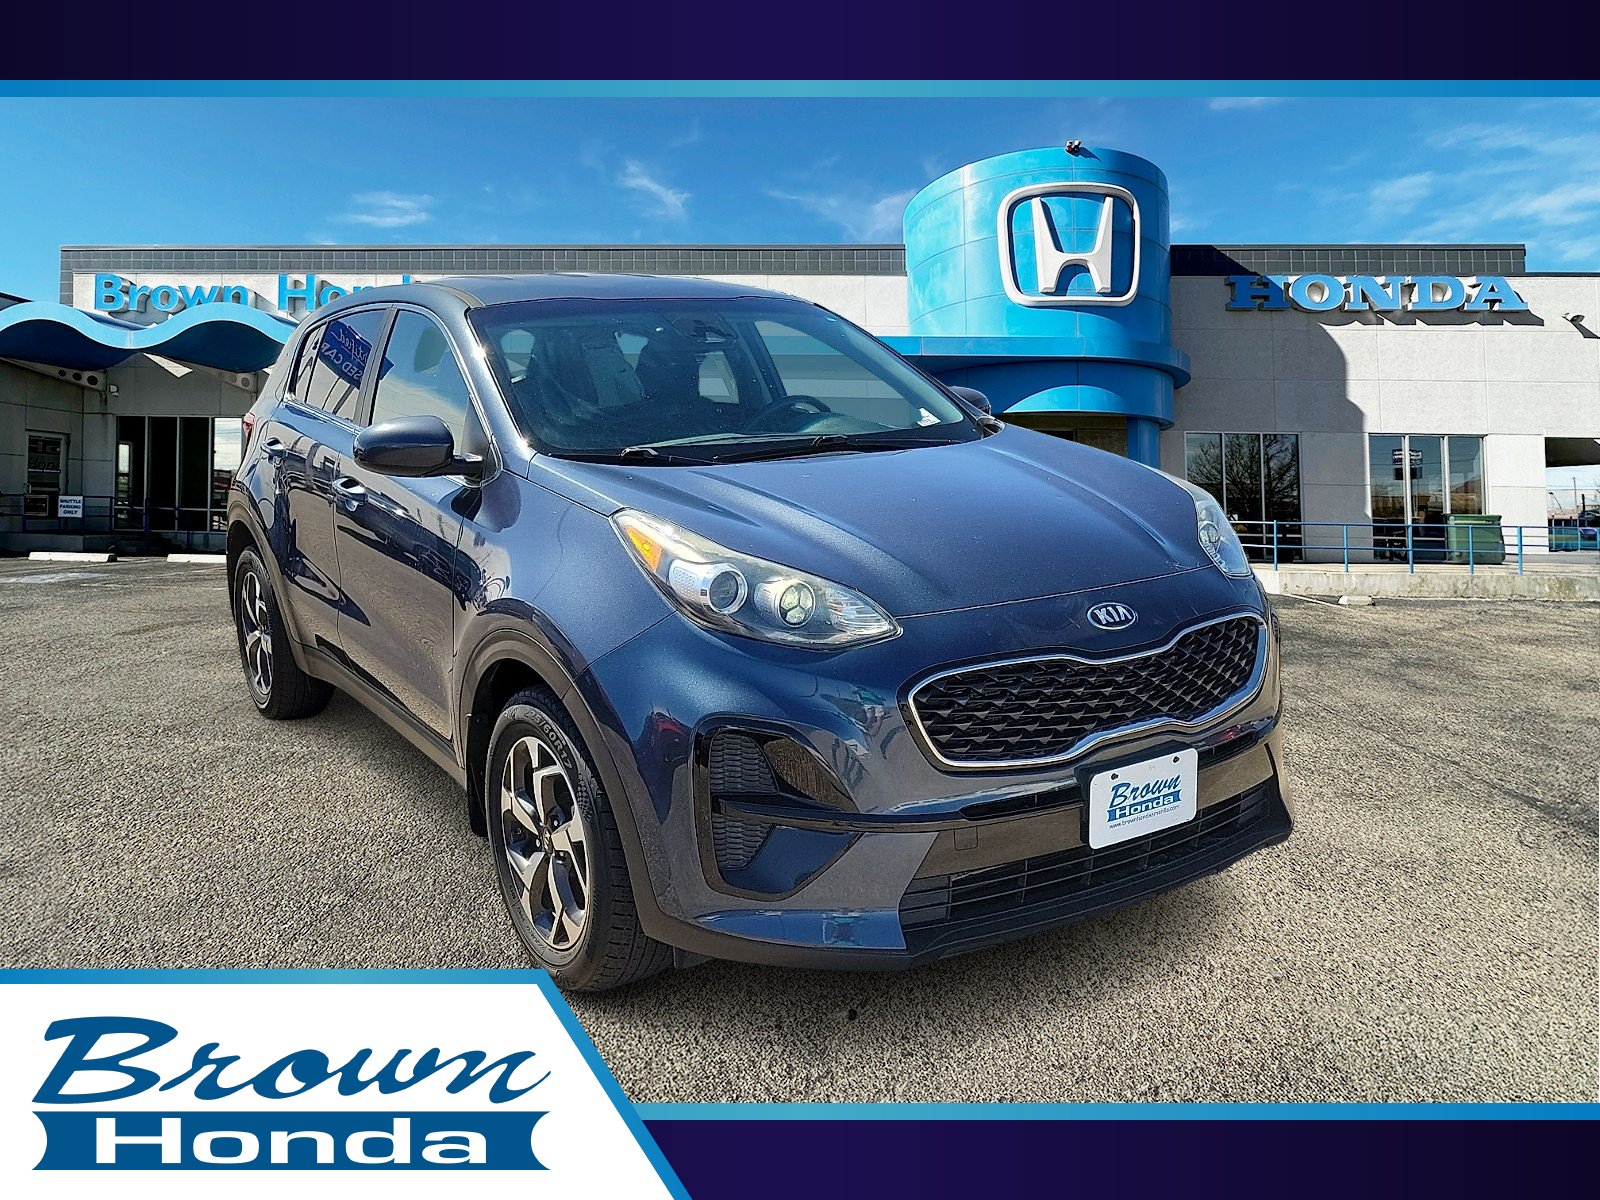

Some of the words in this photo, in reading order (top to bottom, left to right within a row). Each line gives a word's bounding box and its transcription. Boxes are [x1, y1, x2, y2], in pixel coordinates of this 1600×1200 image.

[94, 273, 250, 312] Brown
[1227, 273, 1528, 312] HONDA
[1093, 605, 1132, 625] KIA
[1109, 774, 1181, 808] Brown
[1114, 794, 1174, 818] Honda
